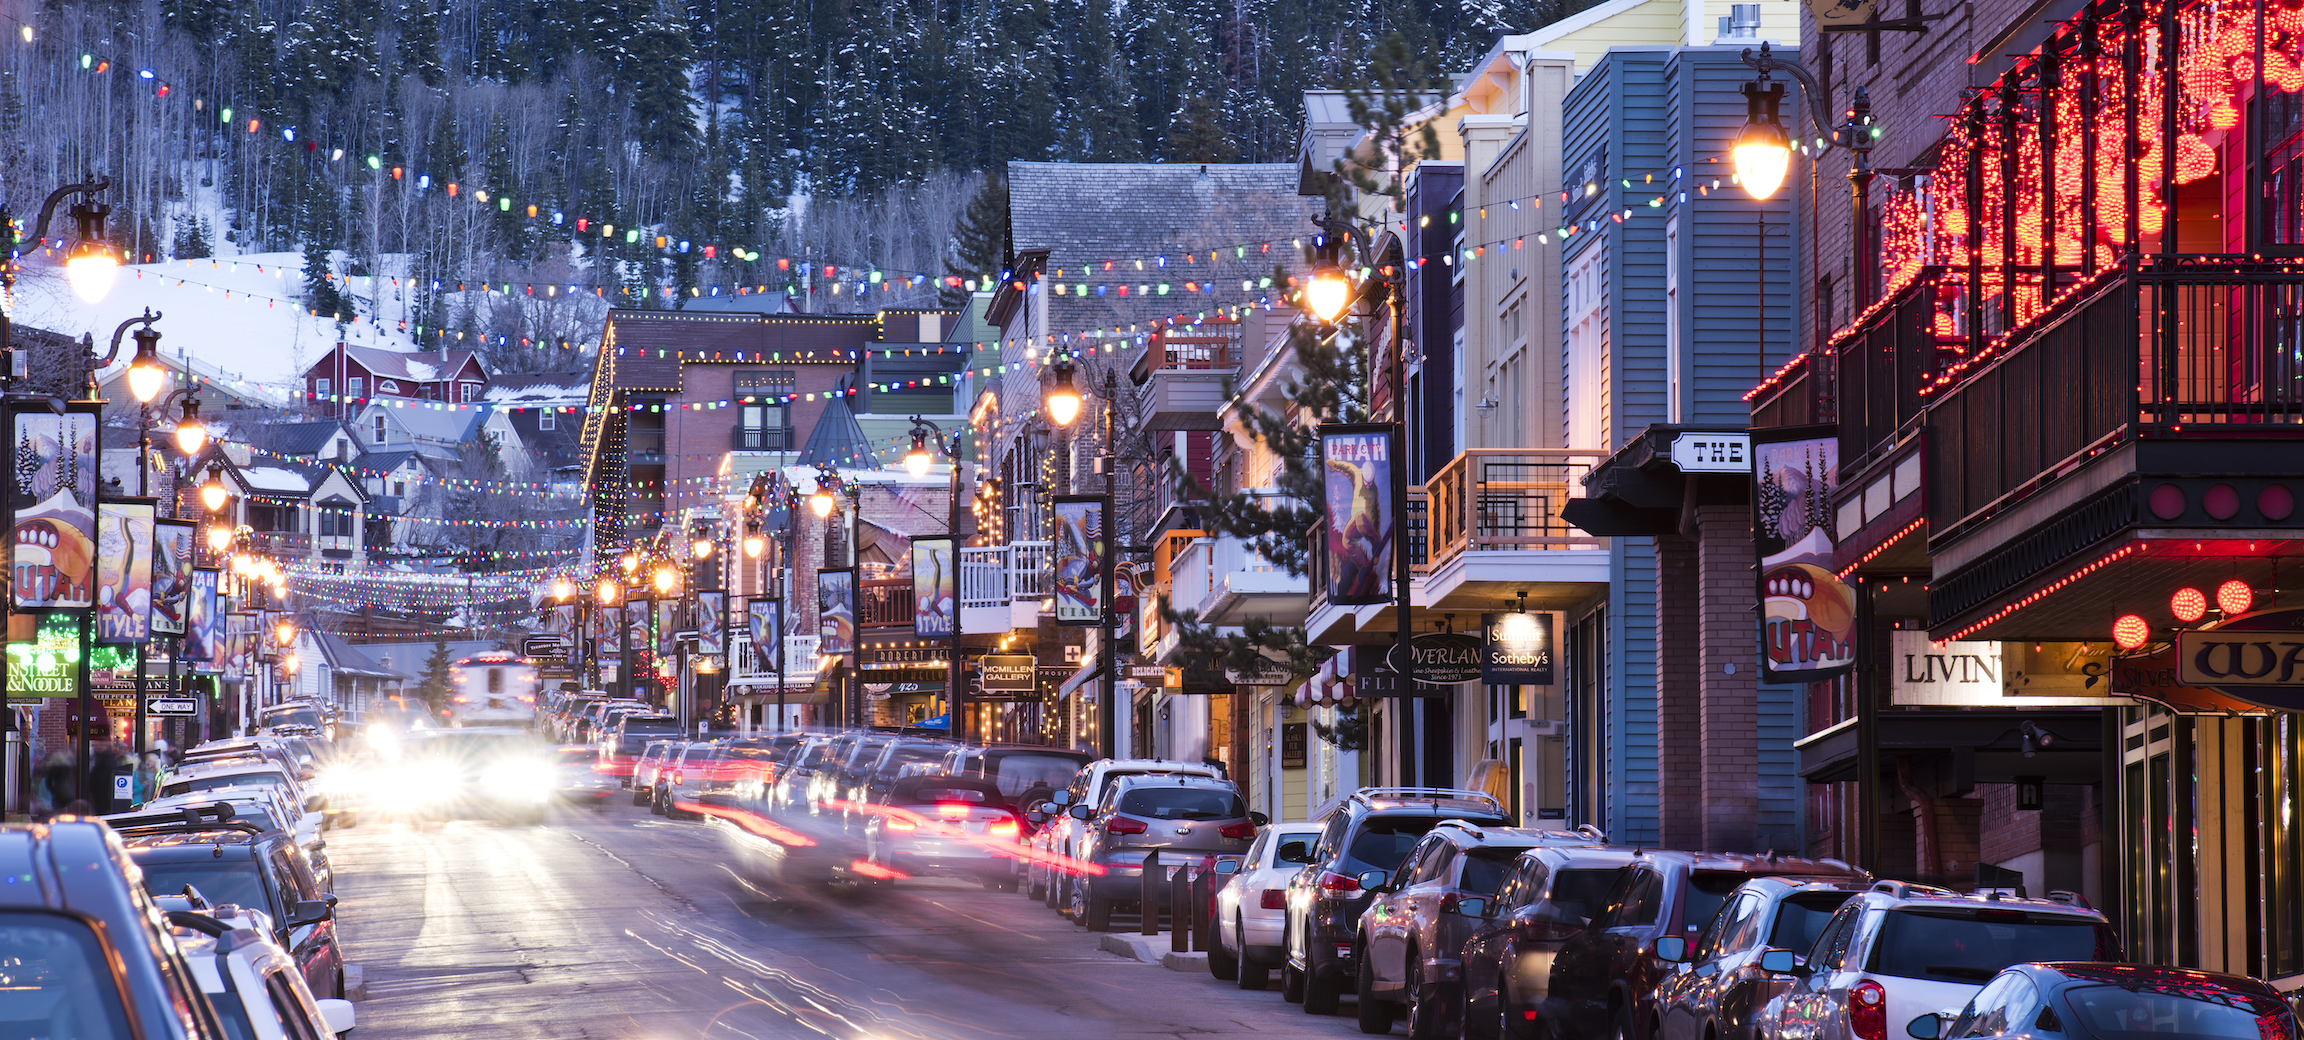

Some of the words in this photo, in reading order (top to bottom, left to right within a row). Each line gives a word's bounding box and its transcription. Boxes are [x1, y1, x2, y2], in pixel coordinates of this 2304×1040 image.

[1327, 436, 1386, 461] UTAH
[1332, 444, 1357, 455] PARK
[1361, 443, 1381, 454] CITY
[1693, 442, 1742, 462] THE
[1771, 448, 1800, 463] PARK
[1803, 445, 1834, 461] CITY
[17, 564, 93, 602] UTAH
[192, 572, 215, 587] TAH
[750, 603, 776, 614] UTAH
[1060, 606, 1099, 617] UTAH
[98, 613, 147, 639] TYLE
[918, 615, 951, 633] STYLE
[1491, 629, 1541, 641] Summit
[1768, 618, 1857, 664] UTAH
[880, 650, 924, 661] ROBERT
[1411, 644, 1482, 665] VERLAN
[1491, 651, 1548, 667] Sotheby's
[862, 671, 904, 682] ROBERT
[911, 671, 944, 681] KELLY
[984, 665, 1033, 673] MCMILLEN
[899, 682, 919, 691] 425
